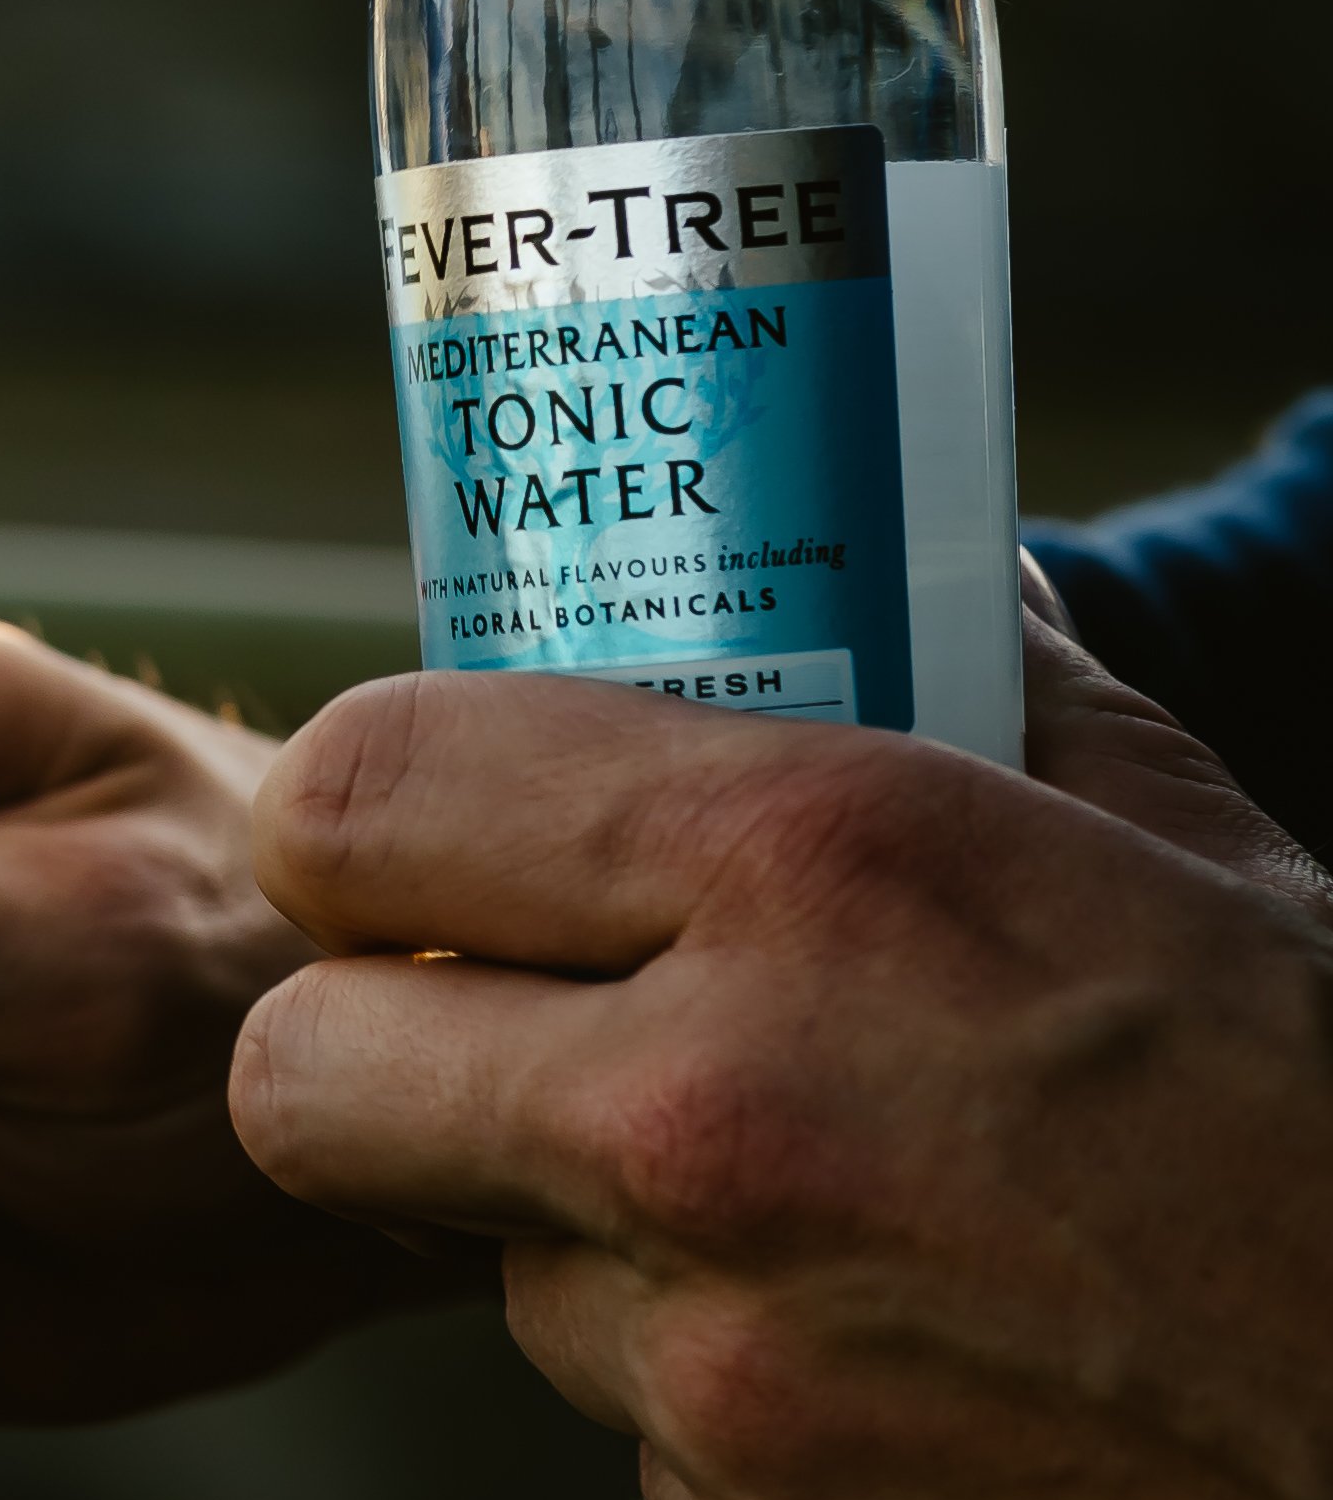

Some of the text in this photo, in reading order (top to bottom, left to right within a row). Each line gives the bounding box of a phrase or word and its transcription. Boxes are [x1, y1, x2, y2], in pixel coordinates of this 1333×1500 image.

[407, 307, 787, 384] MEDITERRANEAN
[452, 378, 692, 456] TONIC
[455, 459, 718, 538] WATER
[421, 541, 845, 600] WITH NATURAL FLAVOURS including
[451, 589, 775, 640] FLORAL BOTANICALS
[635, 670, 782, 699] RESH
